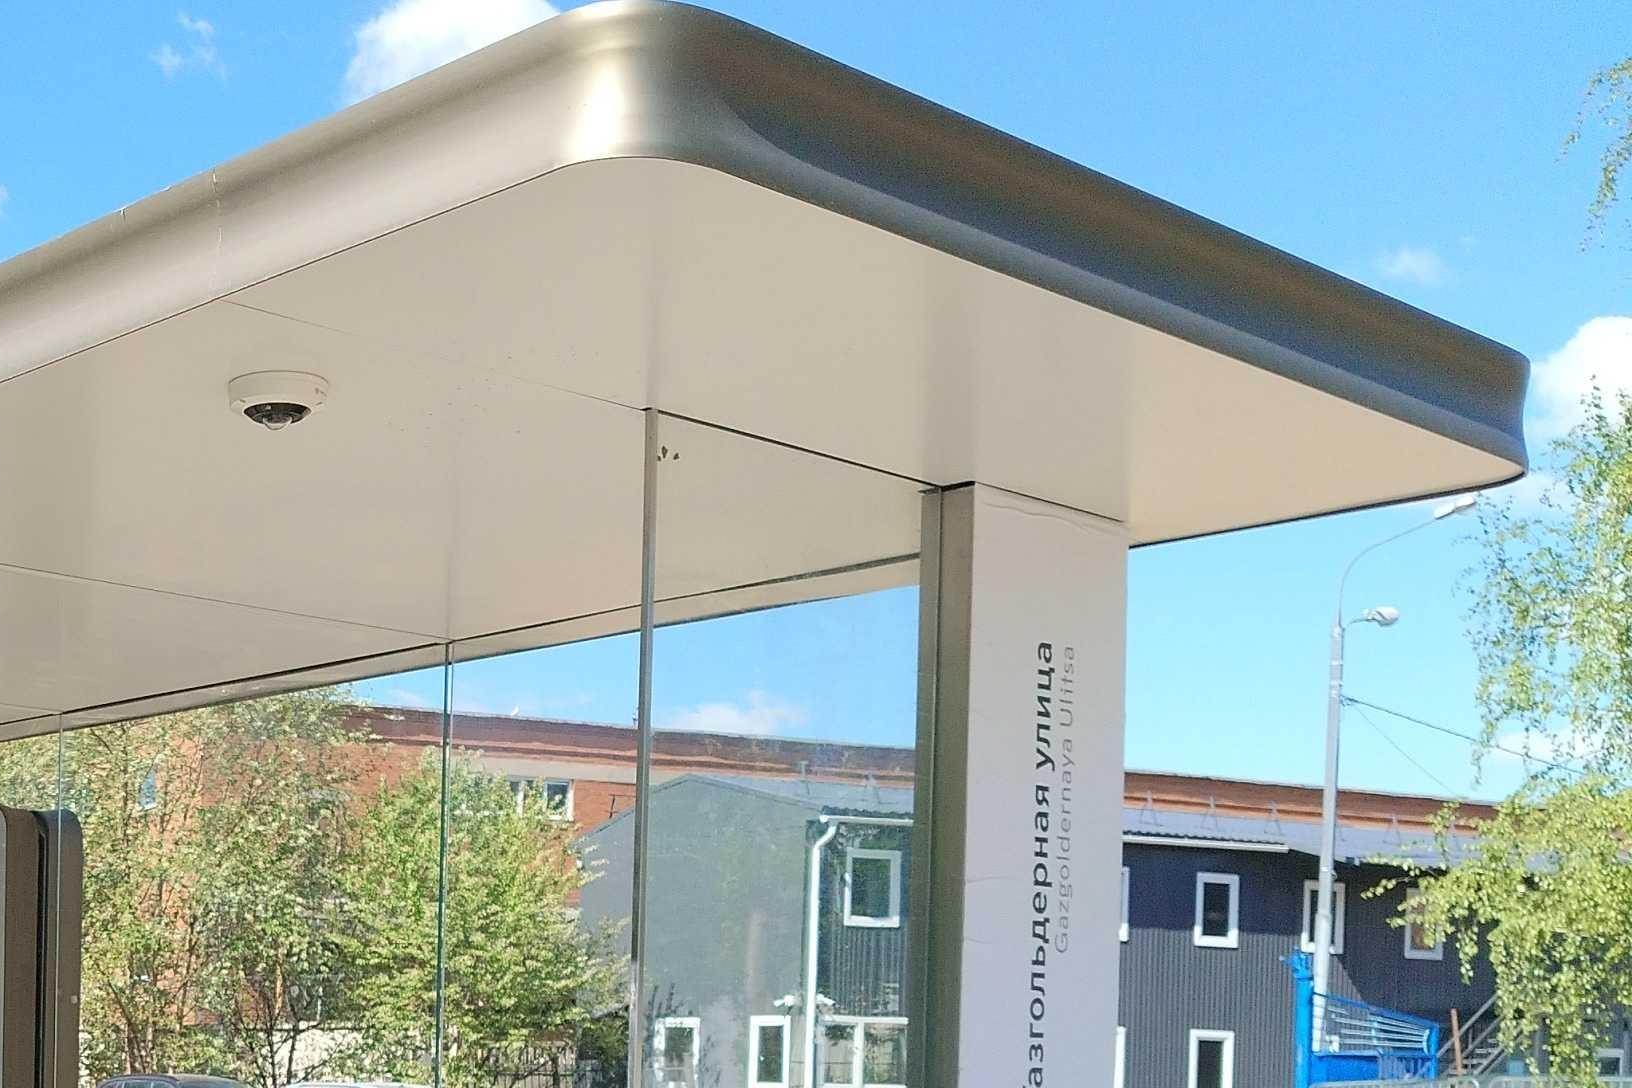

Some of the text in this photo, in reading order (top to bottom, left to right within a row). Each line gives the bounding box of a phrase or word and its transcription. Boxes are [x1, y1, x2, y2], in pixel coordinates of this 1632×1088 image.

[1035, 642, 1055, 772] улица
[1055, 646, 1075, 954] Gazgoldernaya Ulitsa
